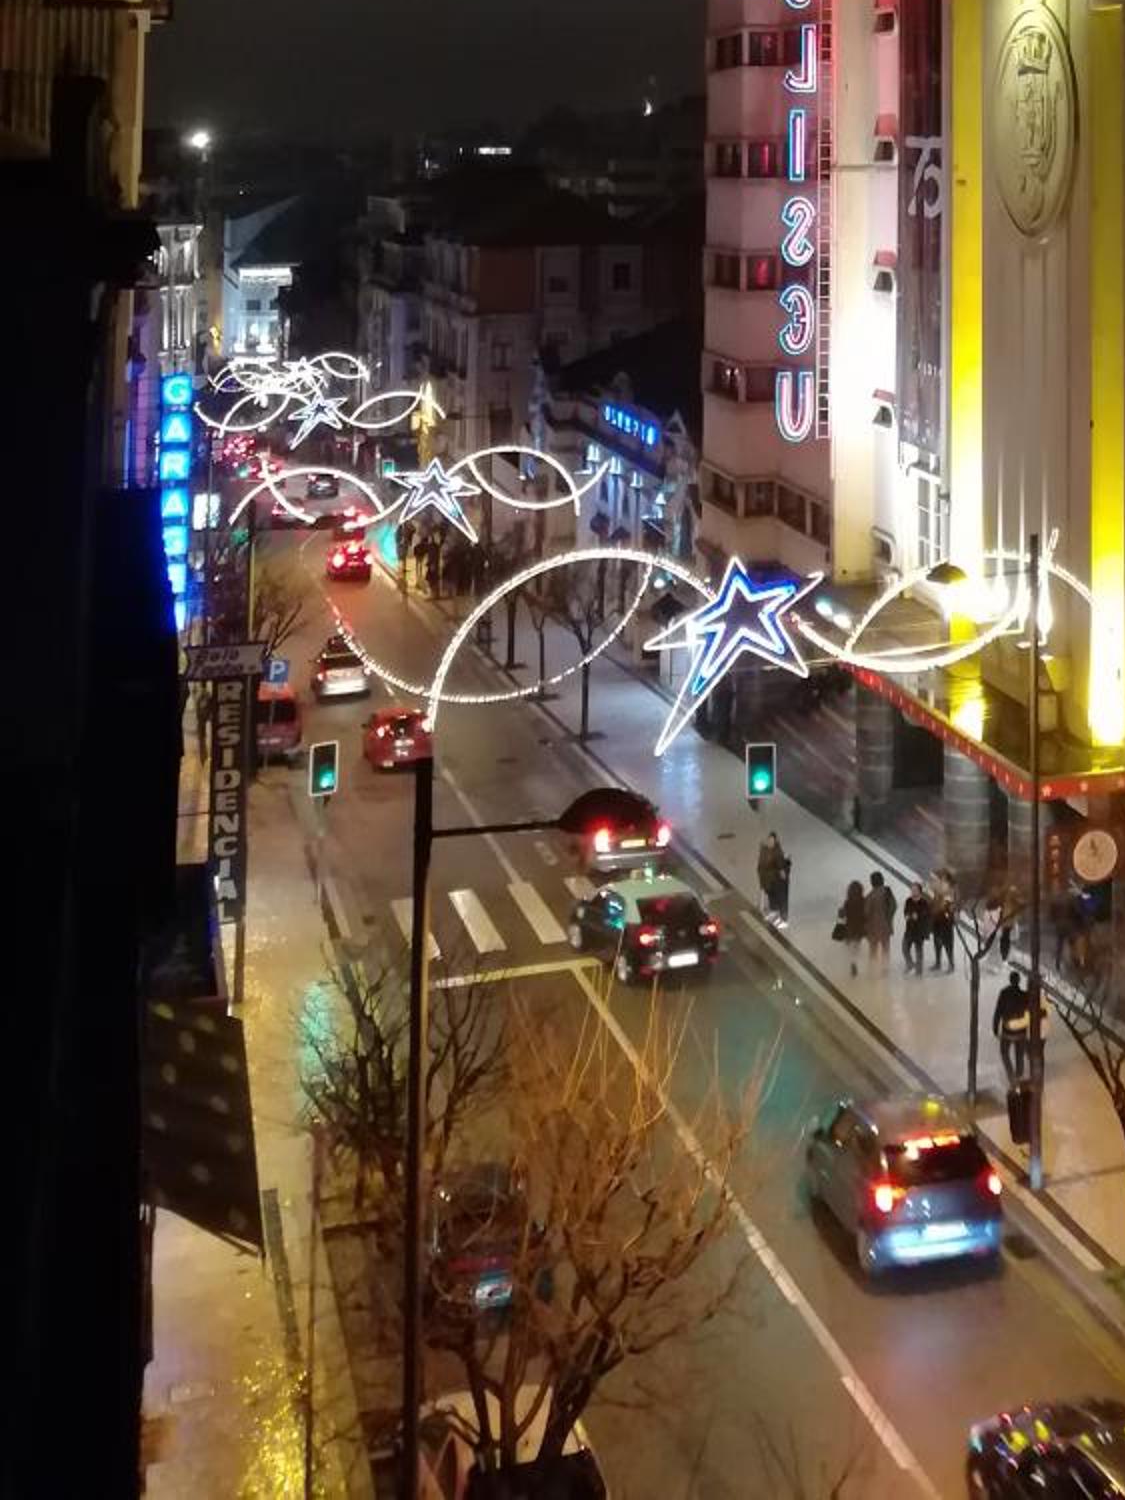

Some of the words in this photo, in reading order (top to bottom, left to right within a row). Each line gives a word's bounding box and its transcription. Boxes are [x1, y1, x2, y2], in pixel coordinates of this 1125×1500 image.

[160, 373, 192, 632] GARAG
[268, 660, 286, 681] P
[212, 680, 243, 923] RESIDENCIAL
